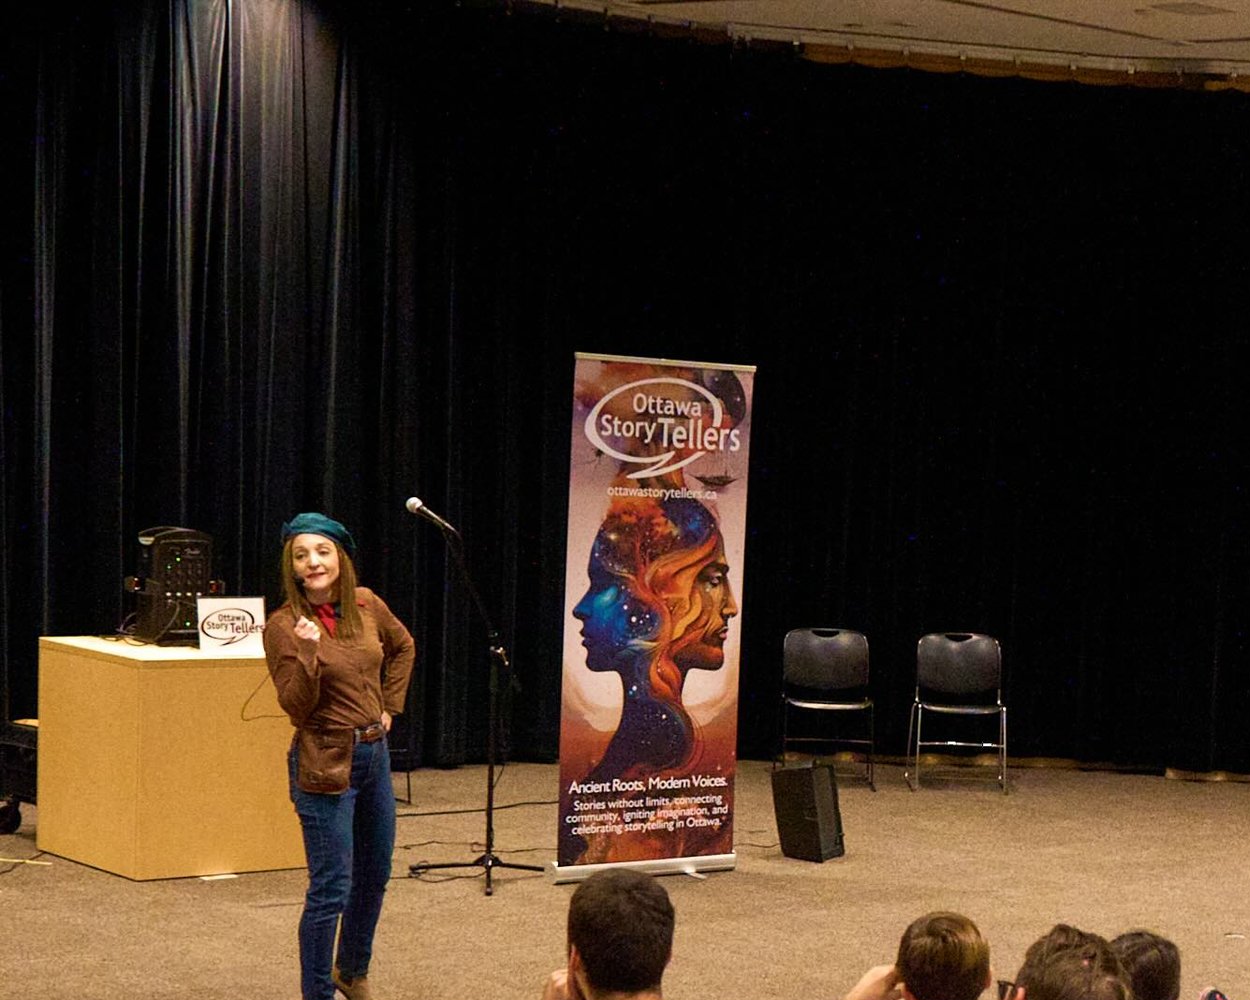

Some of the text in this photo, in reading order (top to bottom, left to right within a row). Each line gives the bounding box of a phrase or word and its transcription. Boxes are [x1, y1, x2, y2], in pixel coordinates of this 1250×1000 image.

[633, 393, 702, 416] Ottawa
[607, 486, 717, 501] ottawastorytellers.ca
[218, 614, 246, 622] Ottawa
[568, 774, 728, 794] Ancient Roots, Modern Voices.
[573, 794, 723, 811] Stories without limits, connecting
[623, 809, 656, 822] igniting
[657, 807, 710, 820] imagination,
[711, 804, 728, 814] and
[571, 816, 722, 835] celebrating storytelling in Ottawa.
